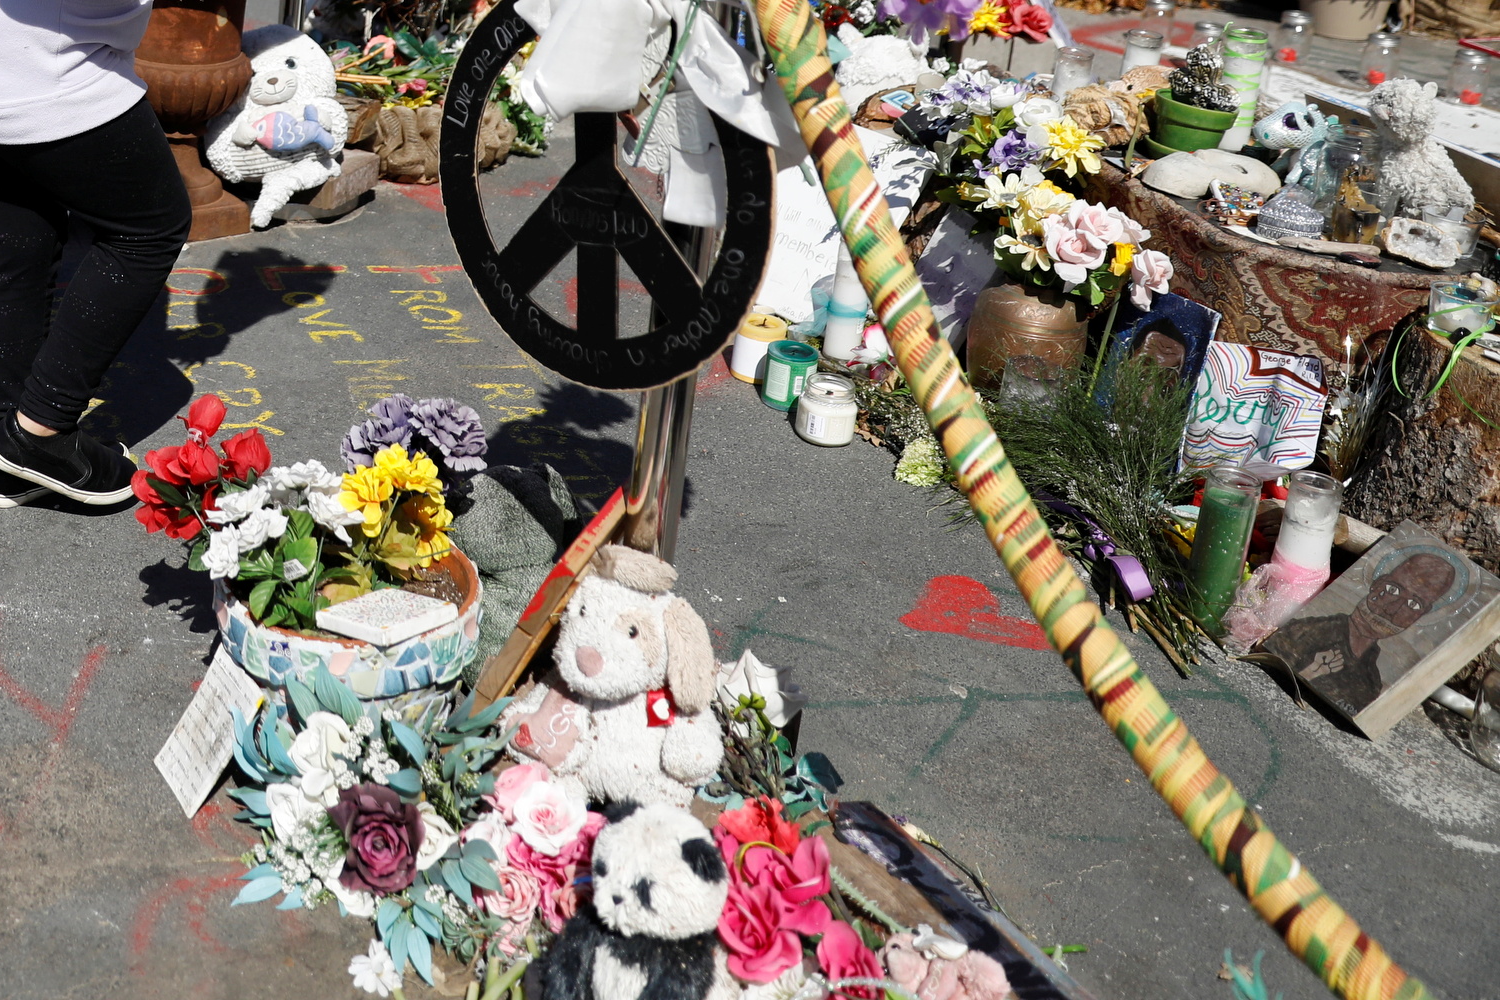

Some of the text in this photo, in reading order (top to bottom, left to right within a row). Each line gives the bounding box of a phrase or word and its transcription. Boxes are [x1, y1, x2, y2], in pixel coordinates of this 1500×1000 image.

[446, 82, 475, 128] Love
[471, 48, 497, 81] one
[713, 247, 746, 296] one
[257, 264, 366, 344] LOVE
[1261, 351, 1292, 366] George
